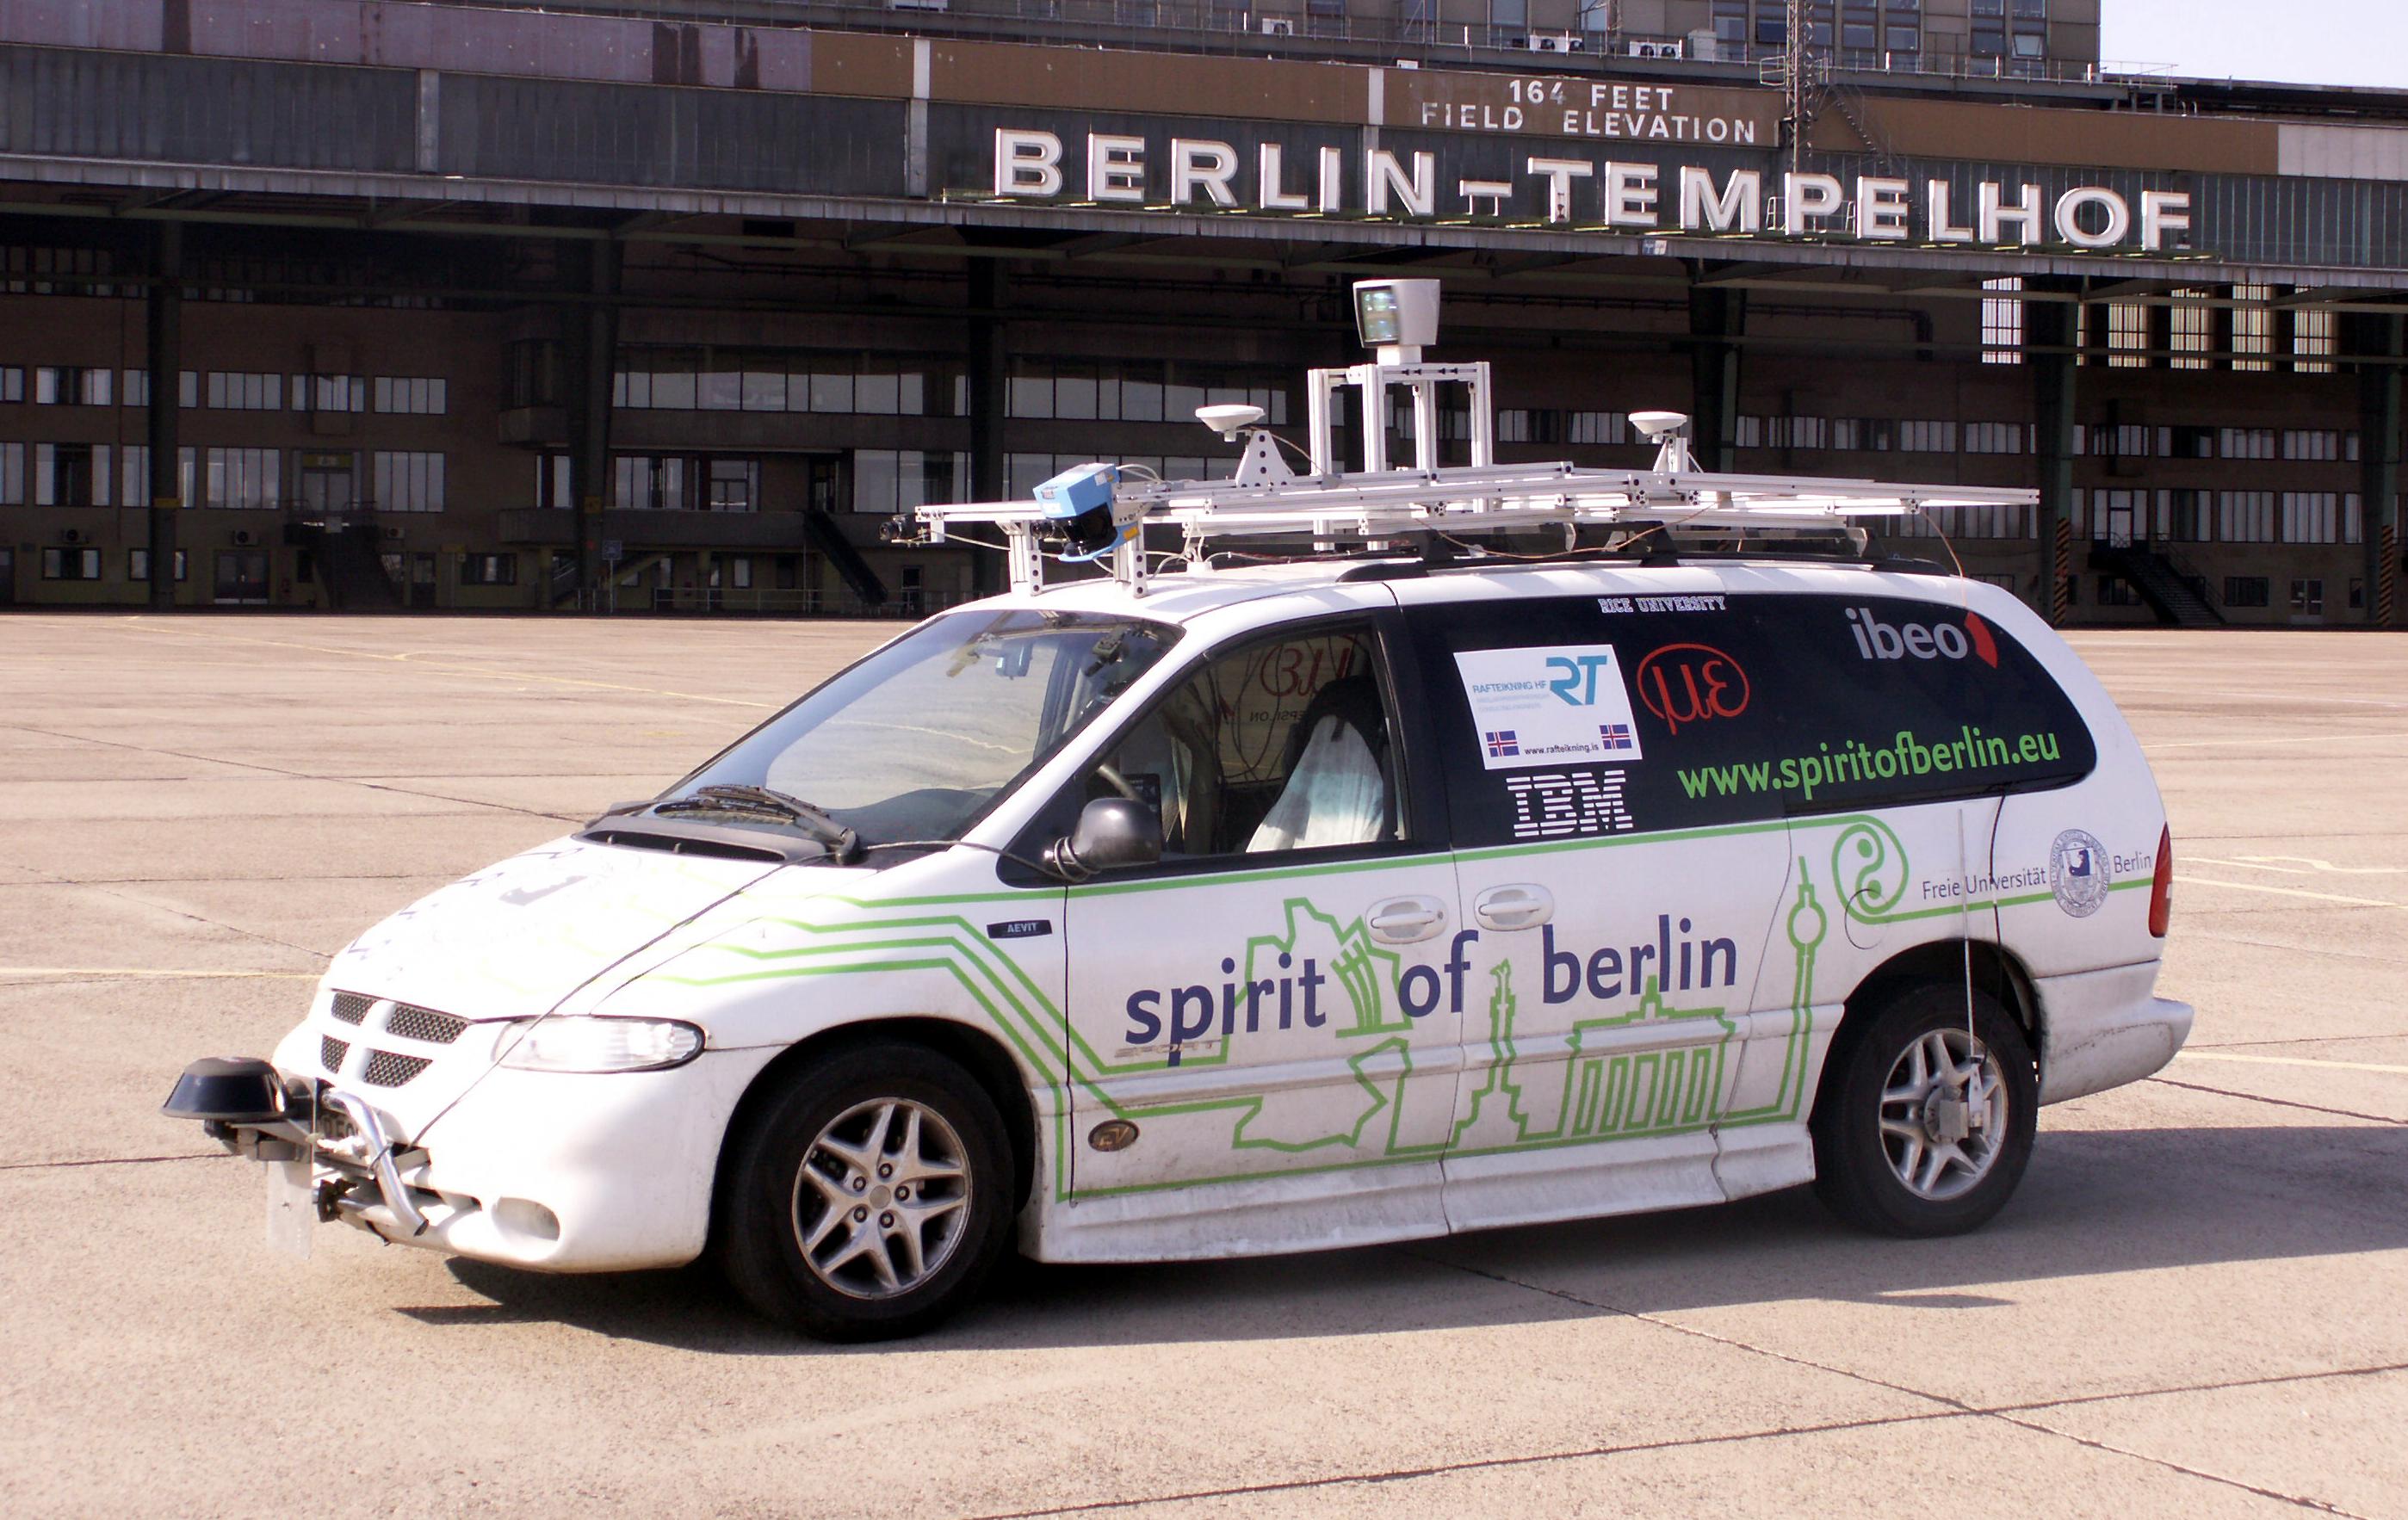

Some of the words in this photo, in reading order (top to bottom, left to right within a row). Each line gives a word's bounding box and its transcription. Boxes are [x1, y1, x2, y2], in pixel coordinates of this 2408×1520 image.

[1508, 79, 1566, 105] 164
[1591, 83, 1674, 111] FEET
[1421, 102, 1524, 130] FIELD
[1563, 109, 1755, 144] ELEVATION
[1597, 597, 1634, 614] RICE
[1635, 596, 1726, 612] UNIVERSITY
[1845, 608, 1970, 661] ibeo
[1472, 680, 1533, 694] RAFTEIKNING
[1534, 679, 1548, 690] HF
[1545, 654, 1608, 707] RT
[1525, 743, 1600, 756] www.rafteikning.is
[1677, 725, 2061, 801] www.spiritofberlin.eu
[1506, 769, 1634, 838] IBM
[1922, 876, 1961, 900] Freie
[1965, 866, 2047, 895] Universität
[2114, 850, 2153, 874] Berlin
[1007, 922, 1037, 933] AEVIT
[1124, 953, 1328, 1067] spirit
[1399, 929, 1479, 1018] of
[1542, 914, 1738, 1005] berlin
